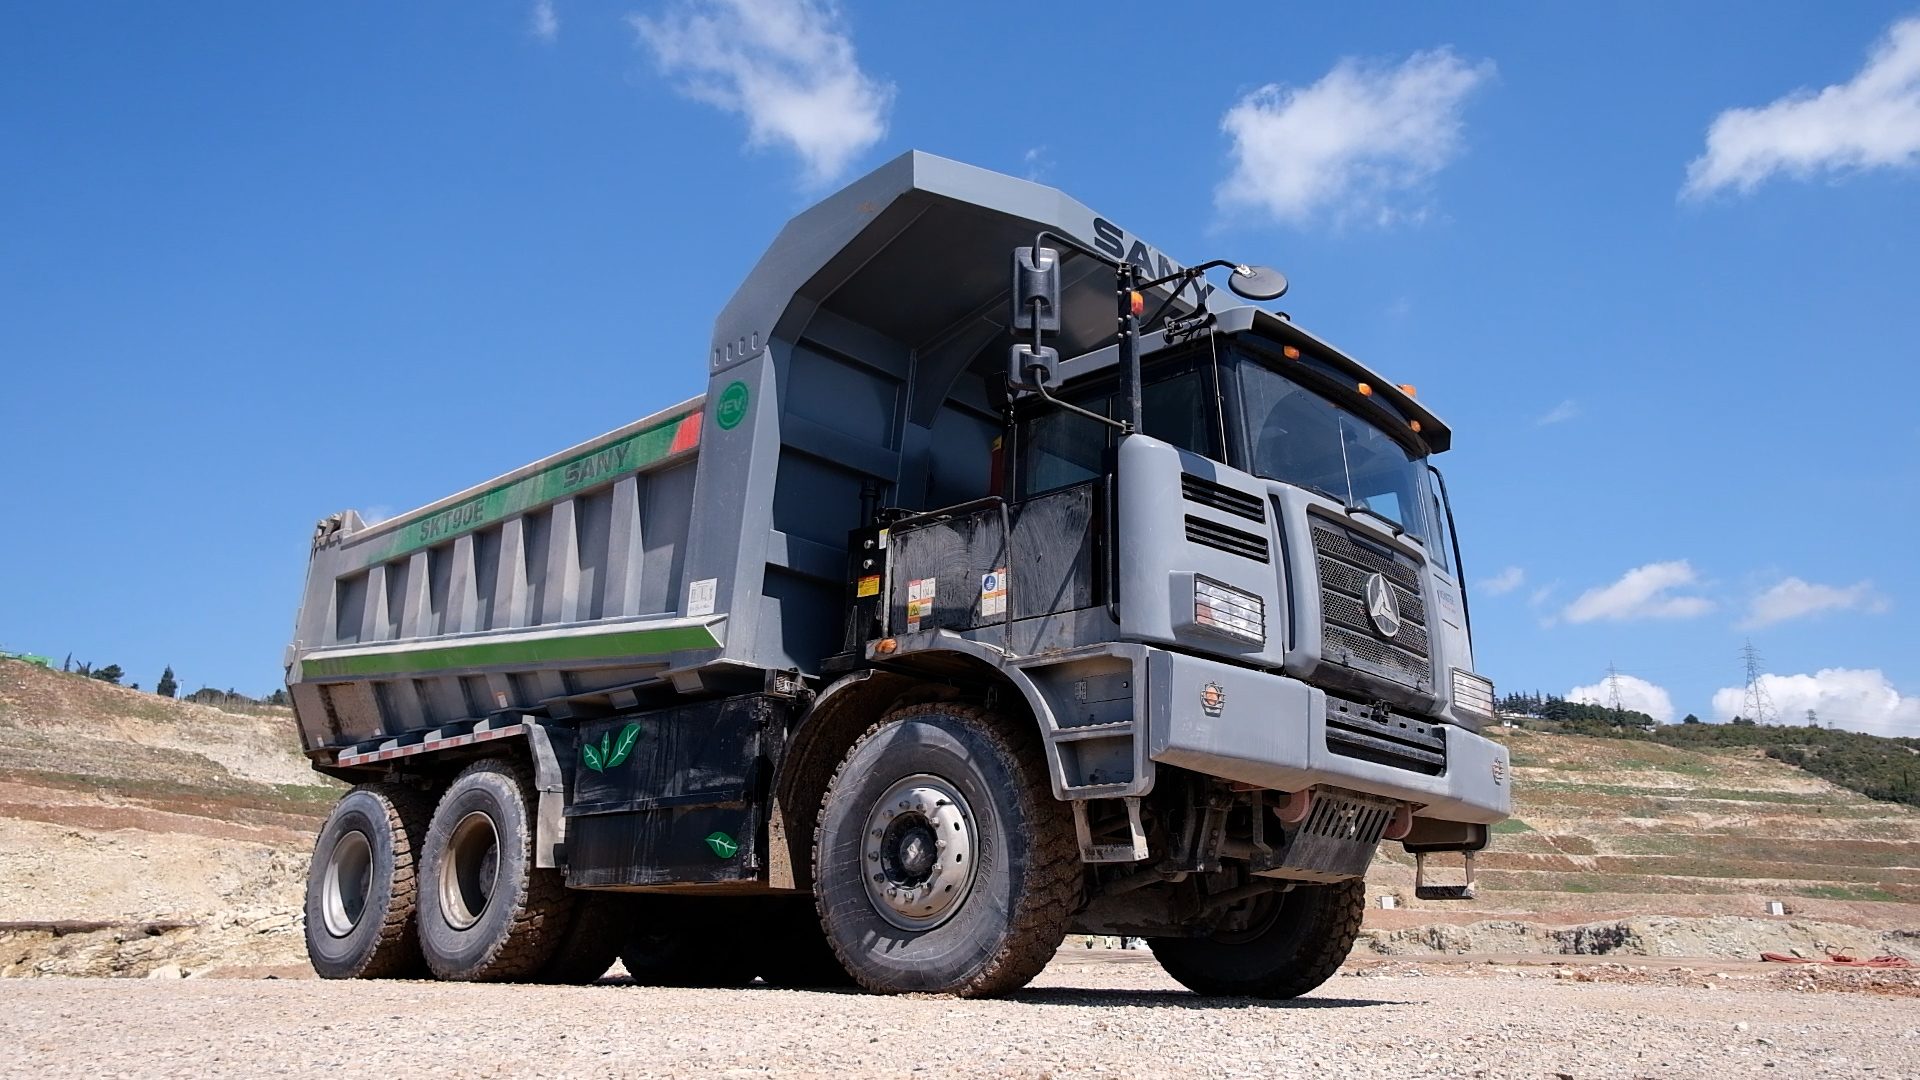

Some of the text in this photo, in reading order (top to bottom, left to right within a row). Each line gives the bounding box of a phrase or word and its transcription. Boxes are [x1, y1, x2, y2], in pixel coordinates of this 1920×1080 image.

[1093, 217, 1215, 305] SANY
[564, 442, 632, 488] SANY
[419, 499, 484, 541] SKT90E
